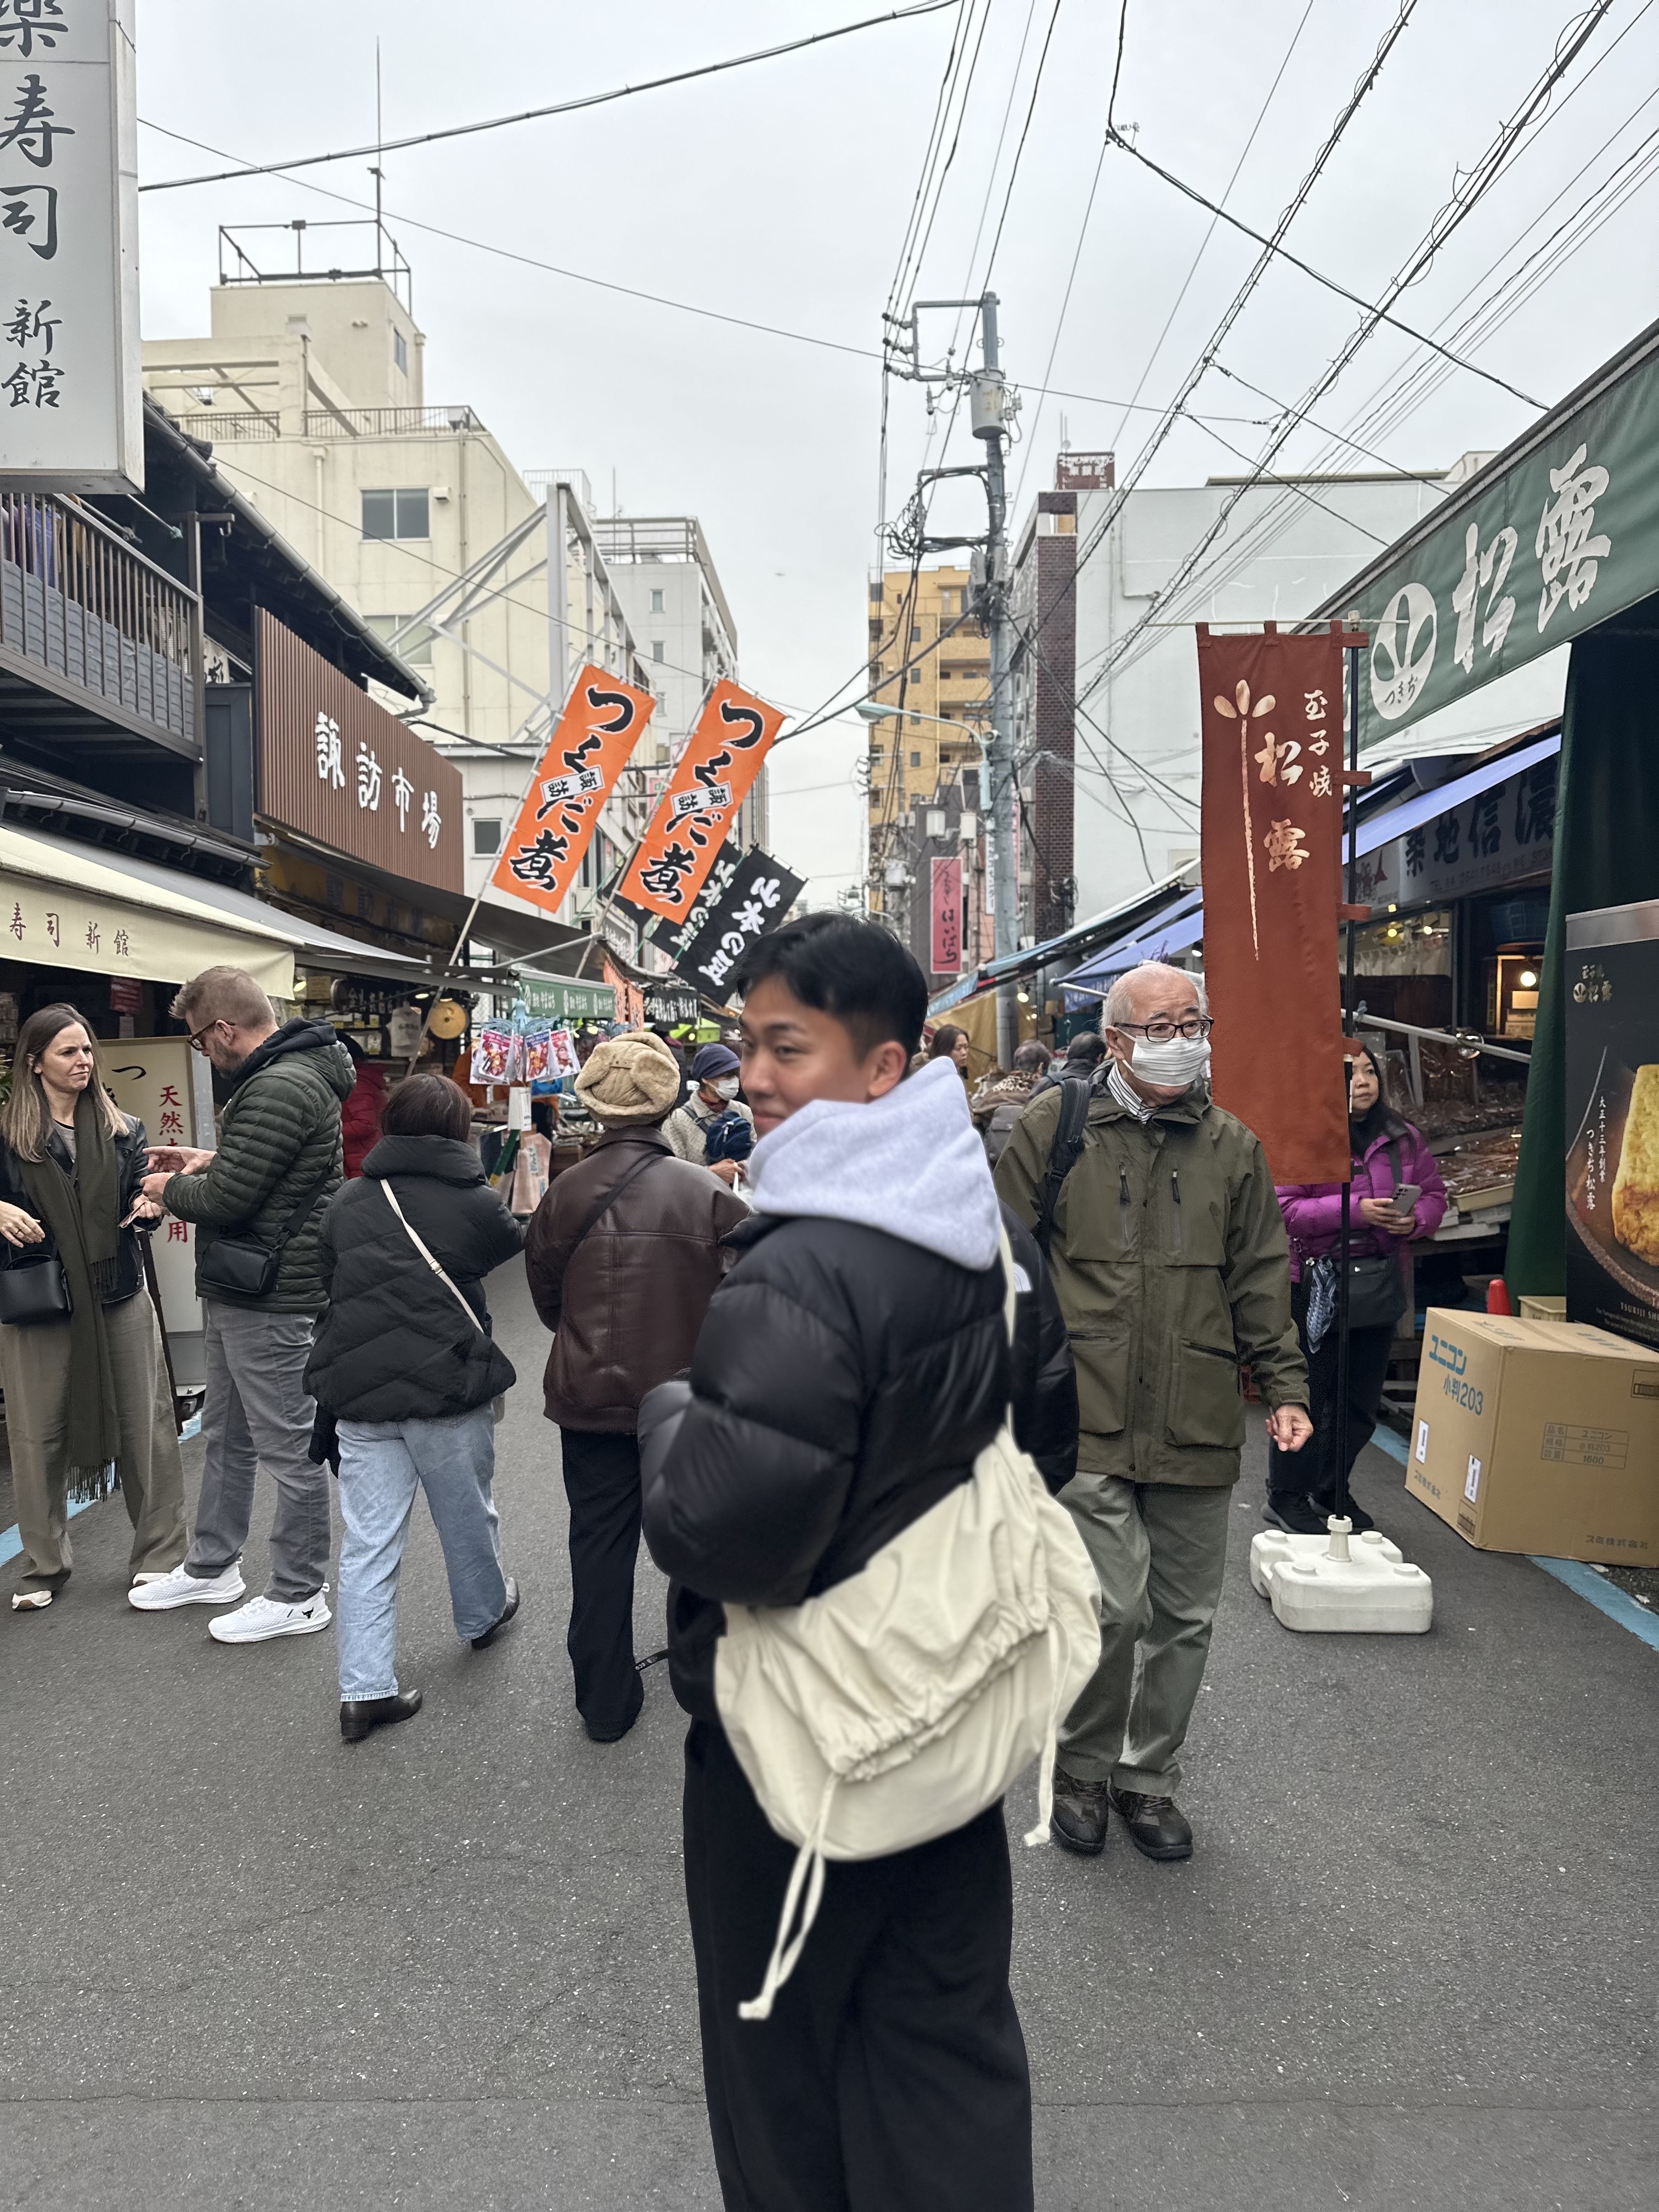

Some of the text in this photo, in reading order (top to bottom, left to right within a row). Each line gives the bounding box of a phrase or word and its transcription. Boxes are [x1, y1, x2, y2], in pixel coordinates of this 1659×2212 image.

[1, 298, 65, 408] 新館
[314, 711, 442, 849] 諏訪市場
[1254, 732, 1310, 872] 松露
[1429, 1335, 1467, 1375] ユニコン
[1443, 1374, 1483, 1415] 小判203
